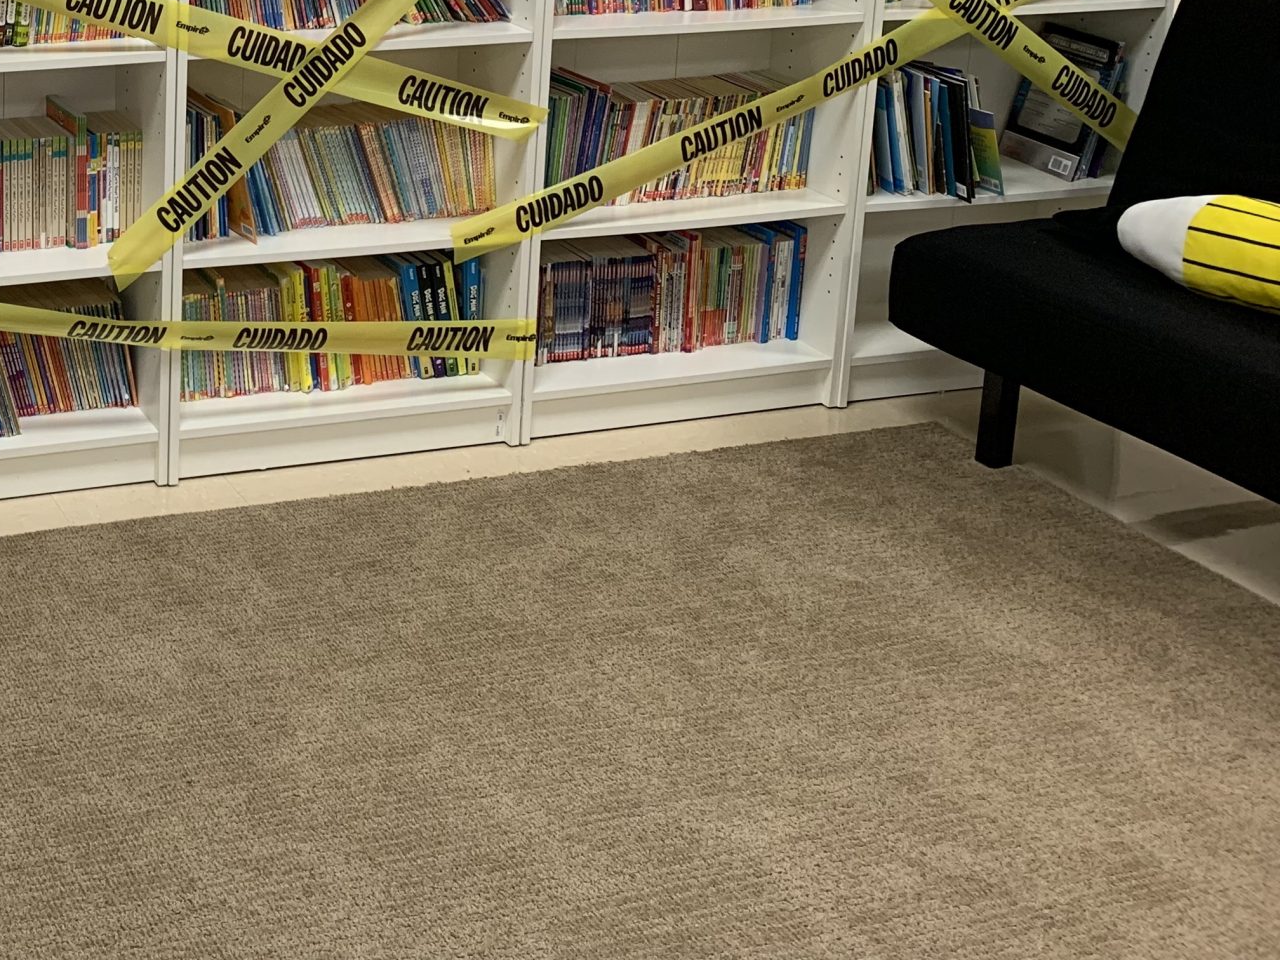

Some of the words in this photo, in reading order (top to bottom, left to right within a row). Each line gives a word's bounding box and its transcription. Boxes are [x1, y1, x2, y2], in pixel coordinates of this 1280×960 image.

[283, 21, 367, 108] CUIDADO
[398, 75, 490, 123] CAUTION
[1051, 64, 1117, 129] CUIDADO
[680, 106, 763, 163] CAUTION
[157, 147, 244, 233] CAUTION
[233, 326, 329, 351] CUIDADO
